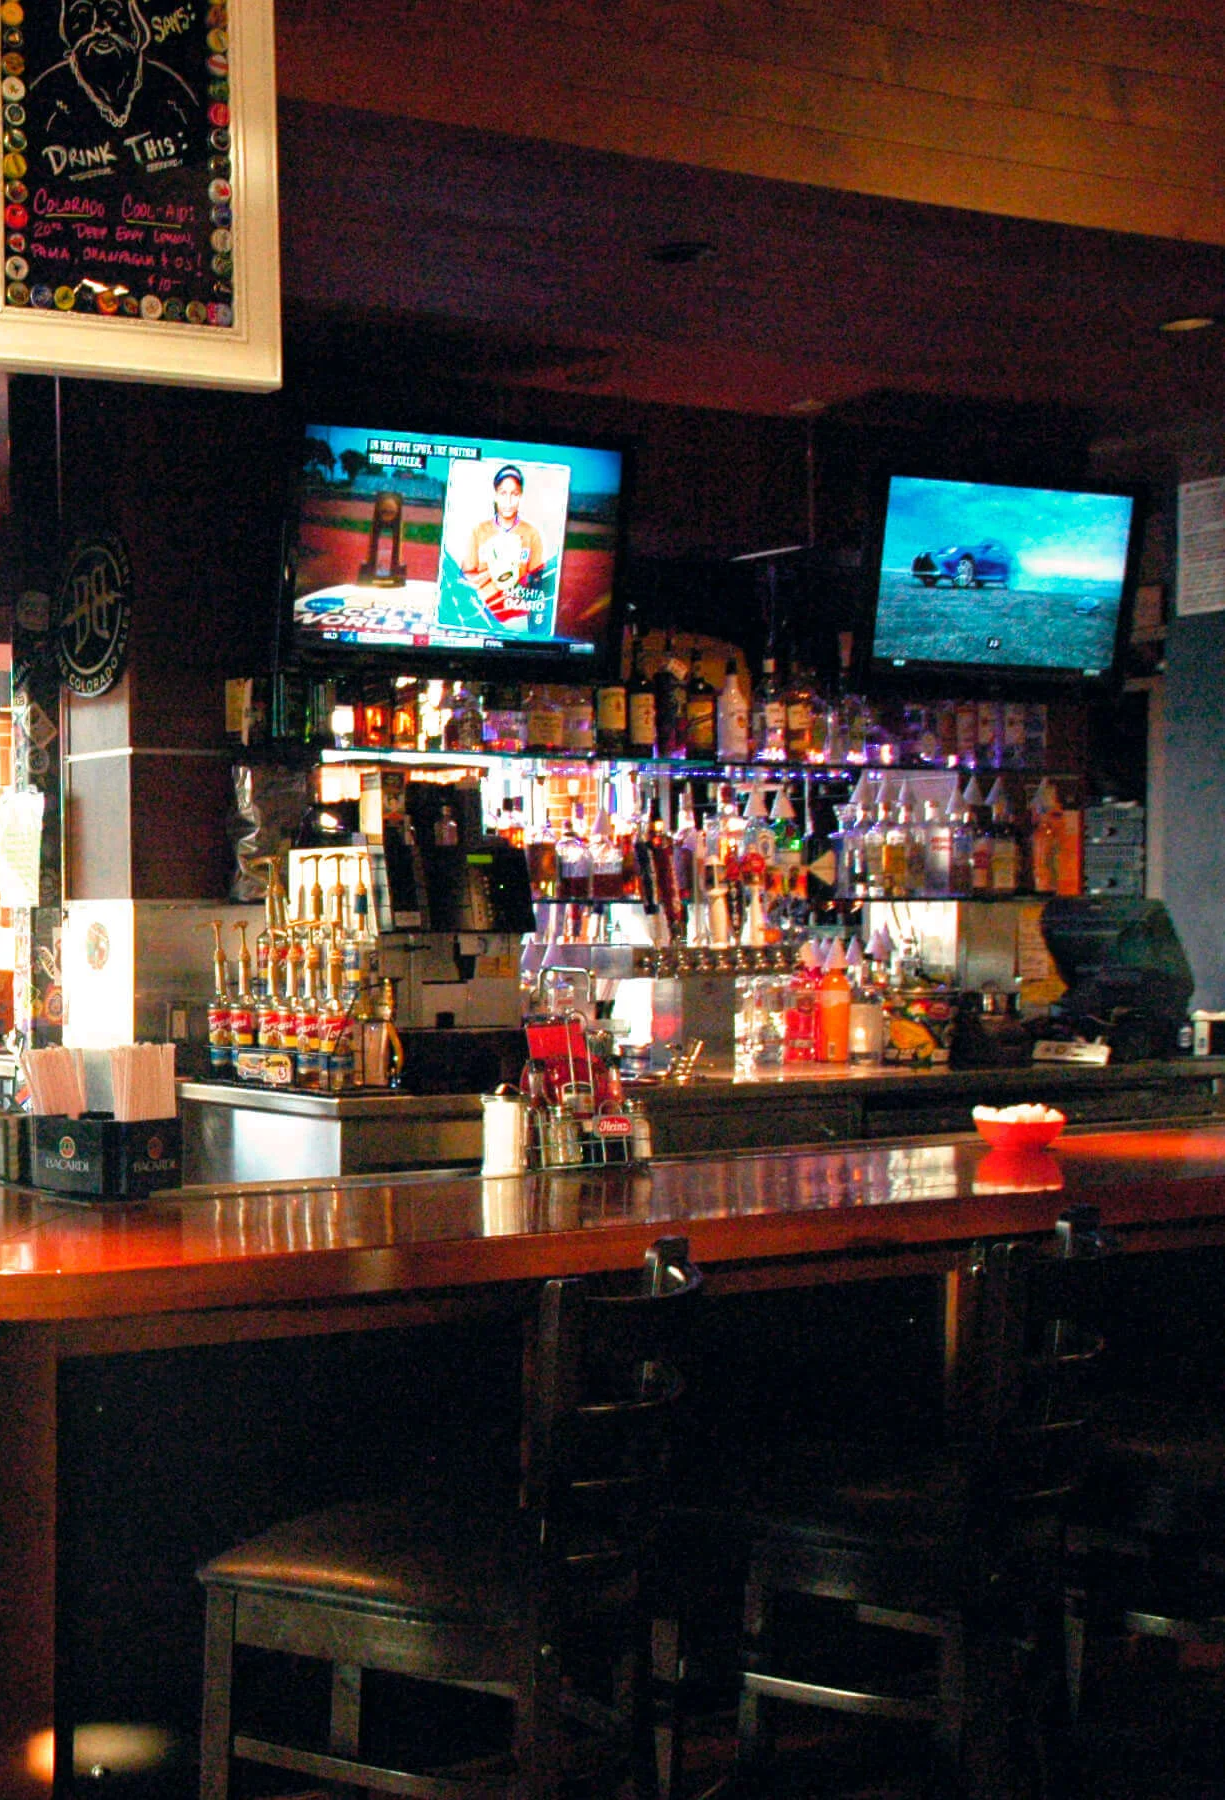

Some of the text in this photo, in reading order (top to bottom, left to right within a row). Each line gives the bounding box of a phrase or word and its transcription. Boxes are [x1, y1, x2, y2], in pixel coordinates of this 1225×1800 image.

[41, 131, 188, 177] DRINK THIS:
[598, 1119, 629, 1132] Heinz
[45, 1158, 90, 1173] BACARDI
